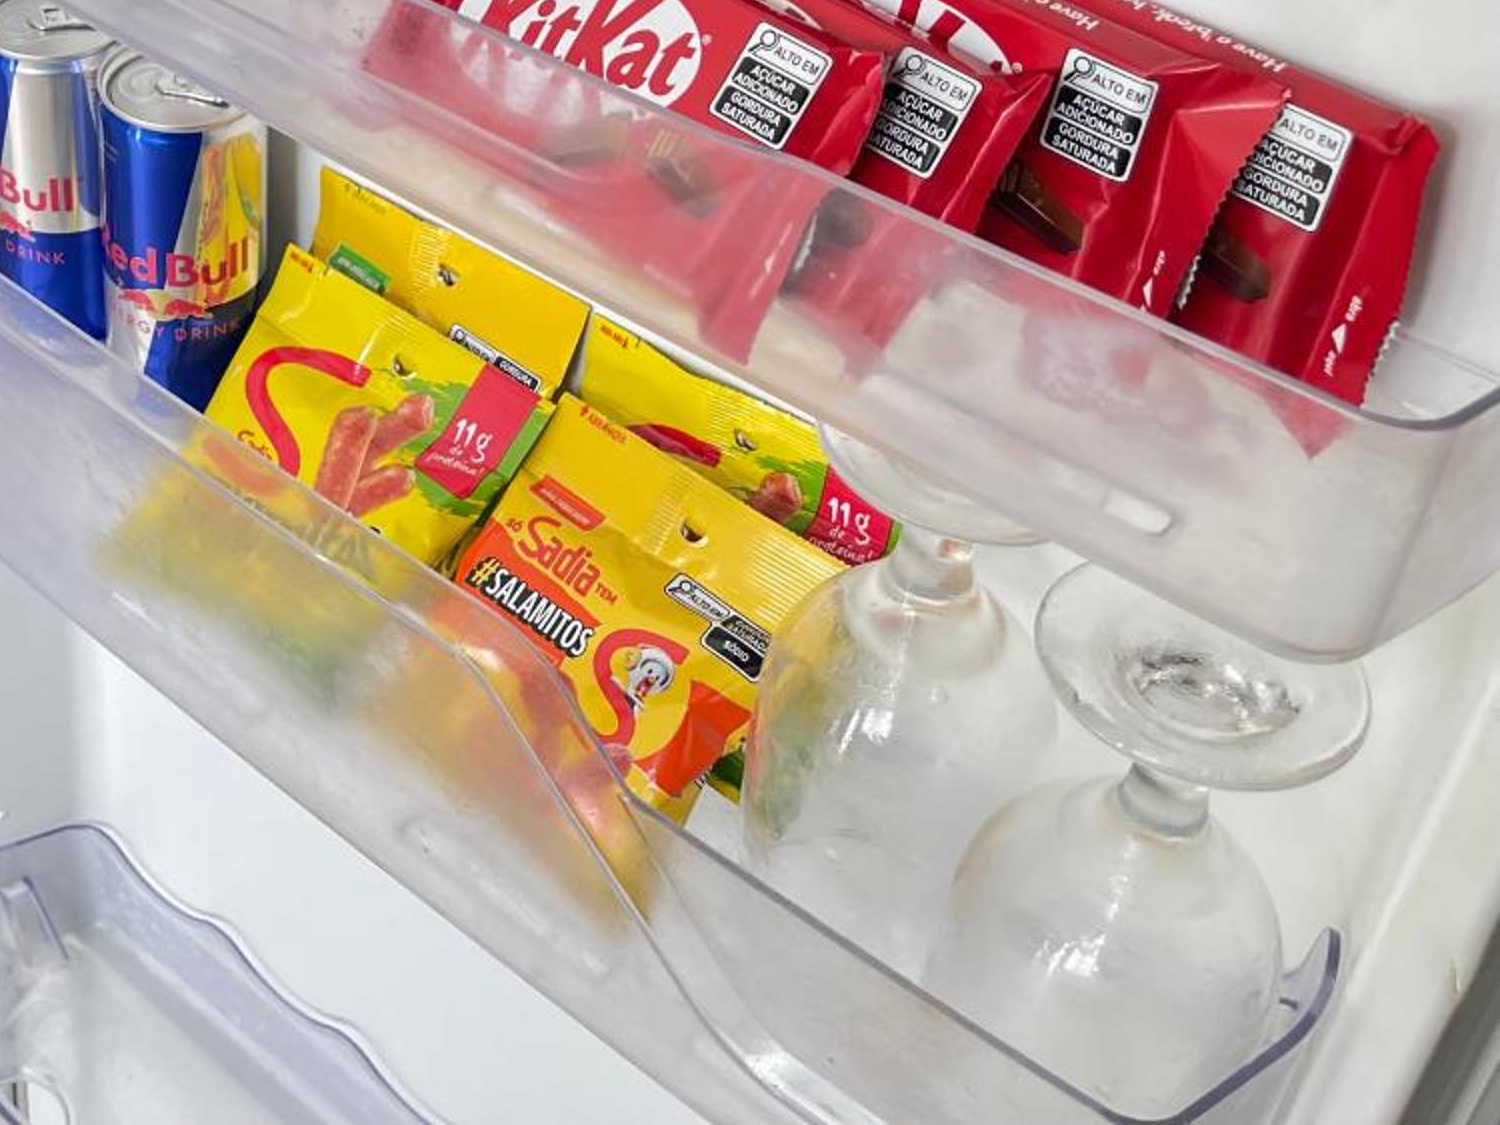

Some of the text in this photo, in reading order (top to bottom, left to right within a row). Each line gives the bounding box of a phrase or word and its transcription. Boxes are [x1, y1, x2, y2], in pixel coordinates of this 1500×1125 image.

[773, 46, 821, 76] ALTO EM
[733, 73, 800, 113] ADICIONADO
[920, 71, 969, 102] ALTO EM
[1091, 73, 1147, 105] ALTO EM
[720, 102, 777, 142] SATURADA
[730, 91, 782, 127] GORDURA
[1056, 102, 1135, 146] ADICIONADO
[1058, 122, 1121, 160] GORDURA
[1280, 116, 1339, 150] ALTO EM
[1051, 135, 1117, 175] SATURADA
[165, 236, 250, 288] Bull
[517, 515, 602, 598] Sadia
[470, 557, 596, 657] #SALAMITOS
